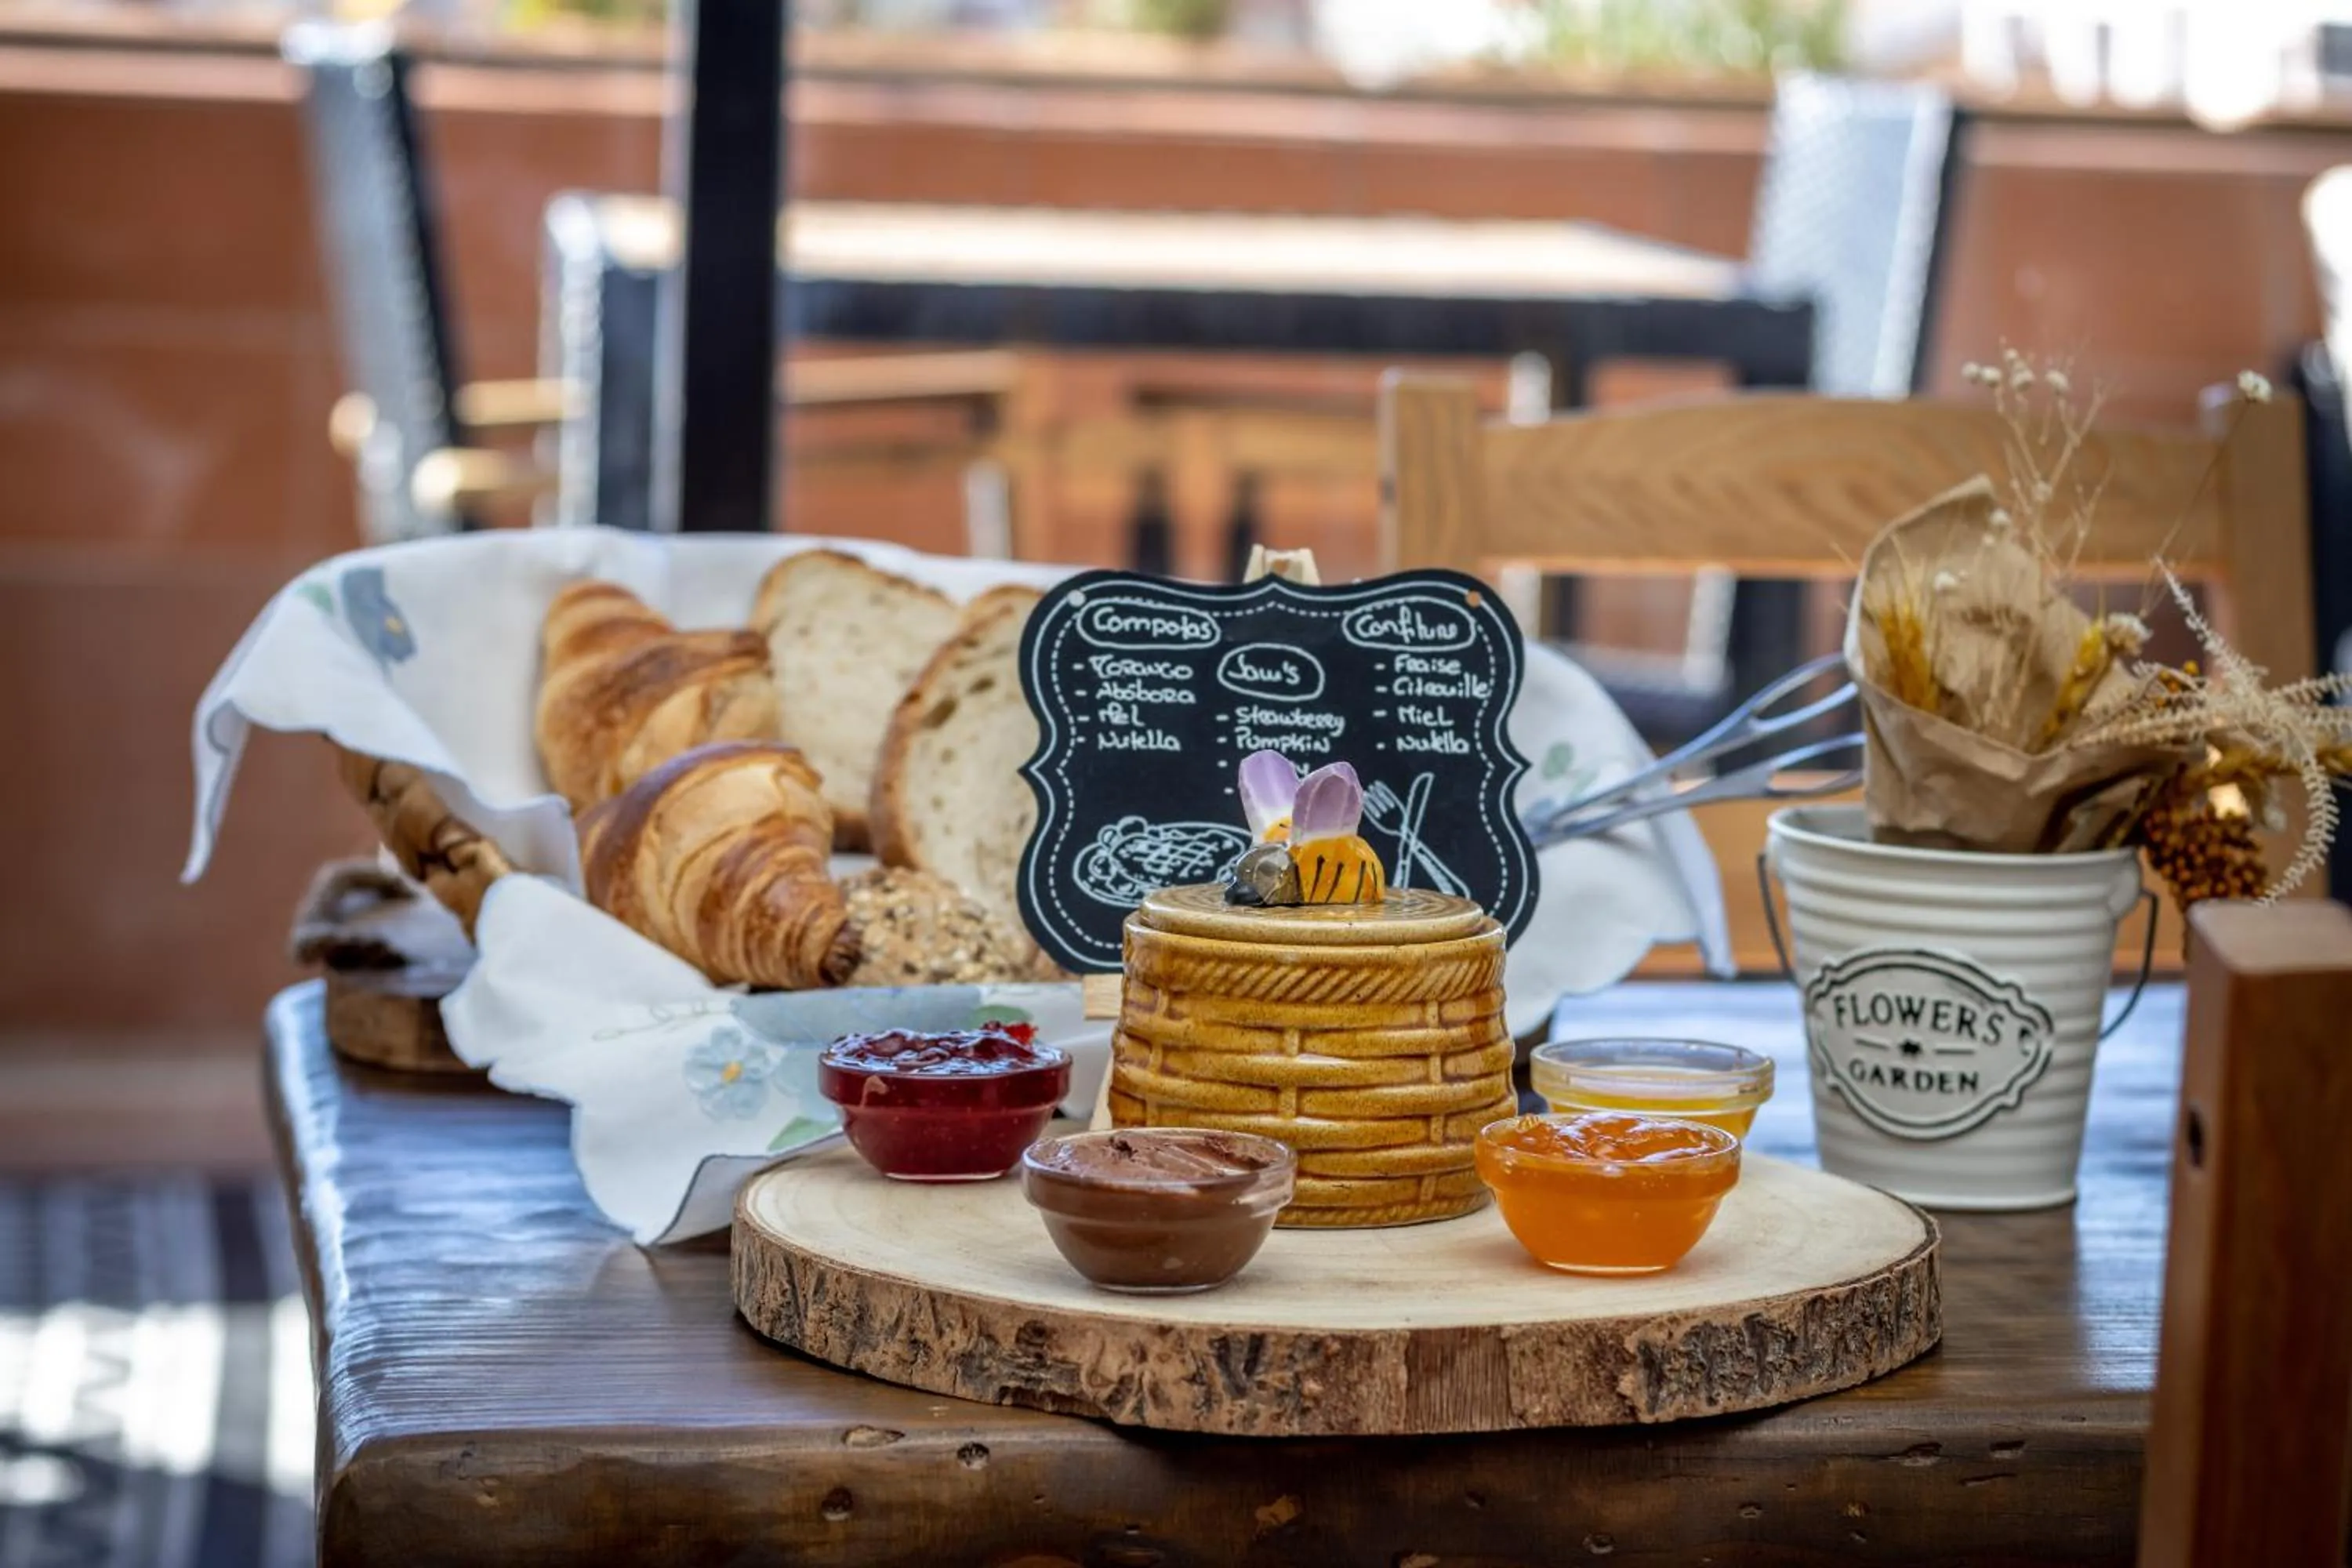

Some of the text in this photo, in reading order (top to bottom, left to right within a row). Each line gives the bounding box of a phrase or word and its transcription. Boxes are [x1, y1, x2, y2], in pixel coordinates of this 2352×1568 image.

[1093, 606, 1213, 641] Compotas
[1834, 993, 2005, 1047] FLOWERS
[1849, 1059, 1980, 1093] GARDEN
